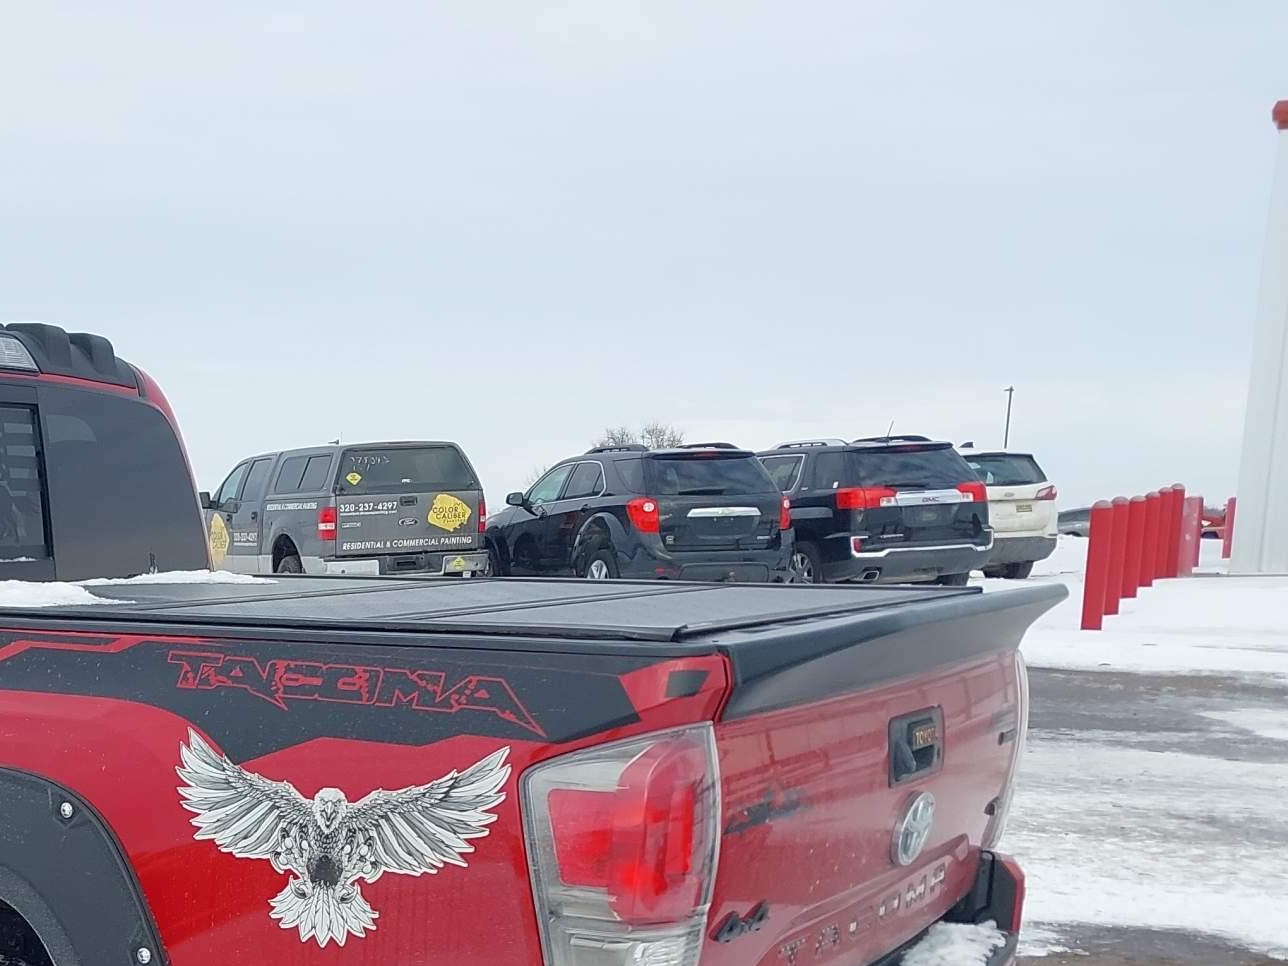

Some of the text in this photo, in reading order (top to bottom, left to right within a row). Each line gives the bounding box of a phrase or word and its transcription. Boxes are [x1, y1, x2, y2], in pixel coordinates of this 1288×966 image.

[339, 501, 398, 512] 320-237-4297
[432, 506, 459, 514] COLOR
[435, 511, 467, 520] CALIBER
[342, 540, 384, 550] RESIDENTIAL
[392, 537, 439, 548] COMMERCIAL
[440, 536, 472, 546] PAINTING
[168, 650, 547, 738] TACOMA
